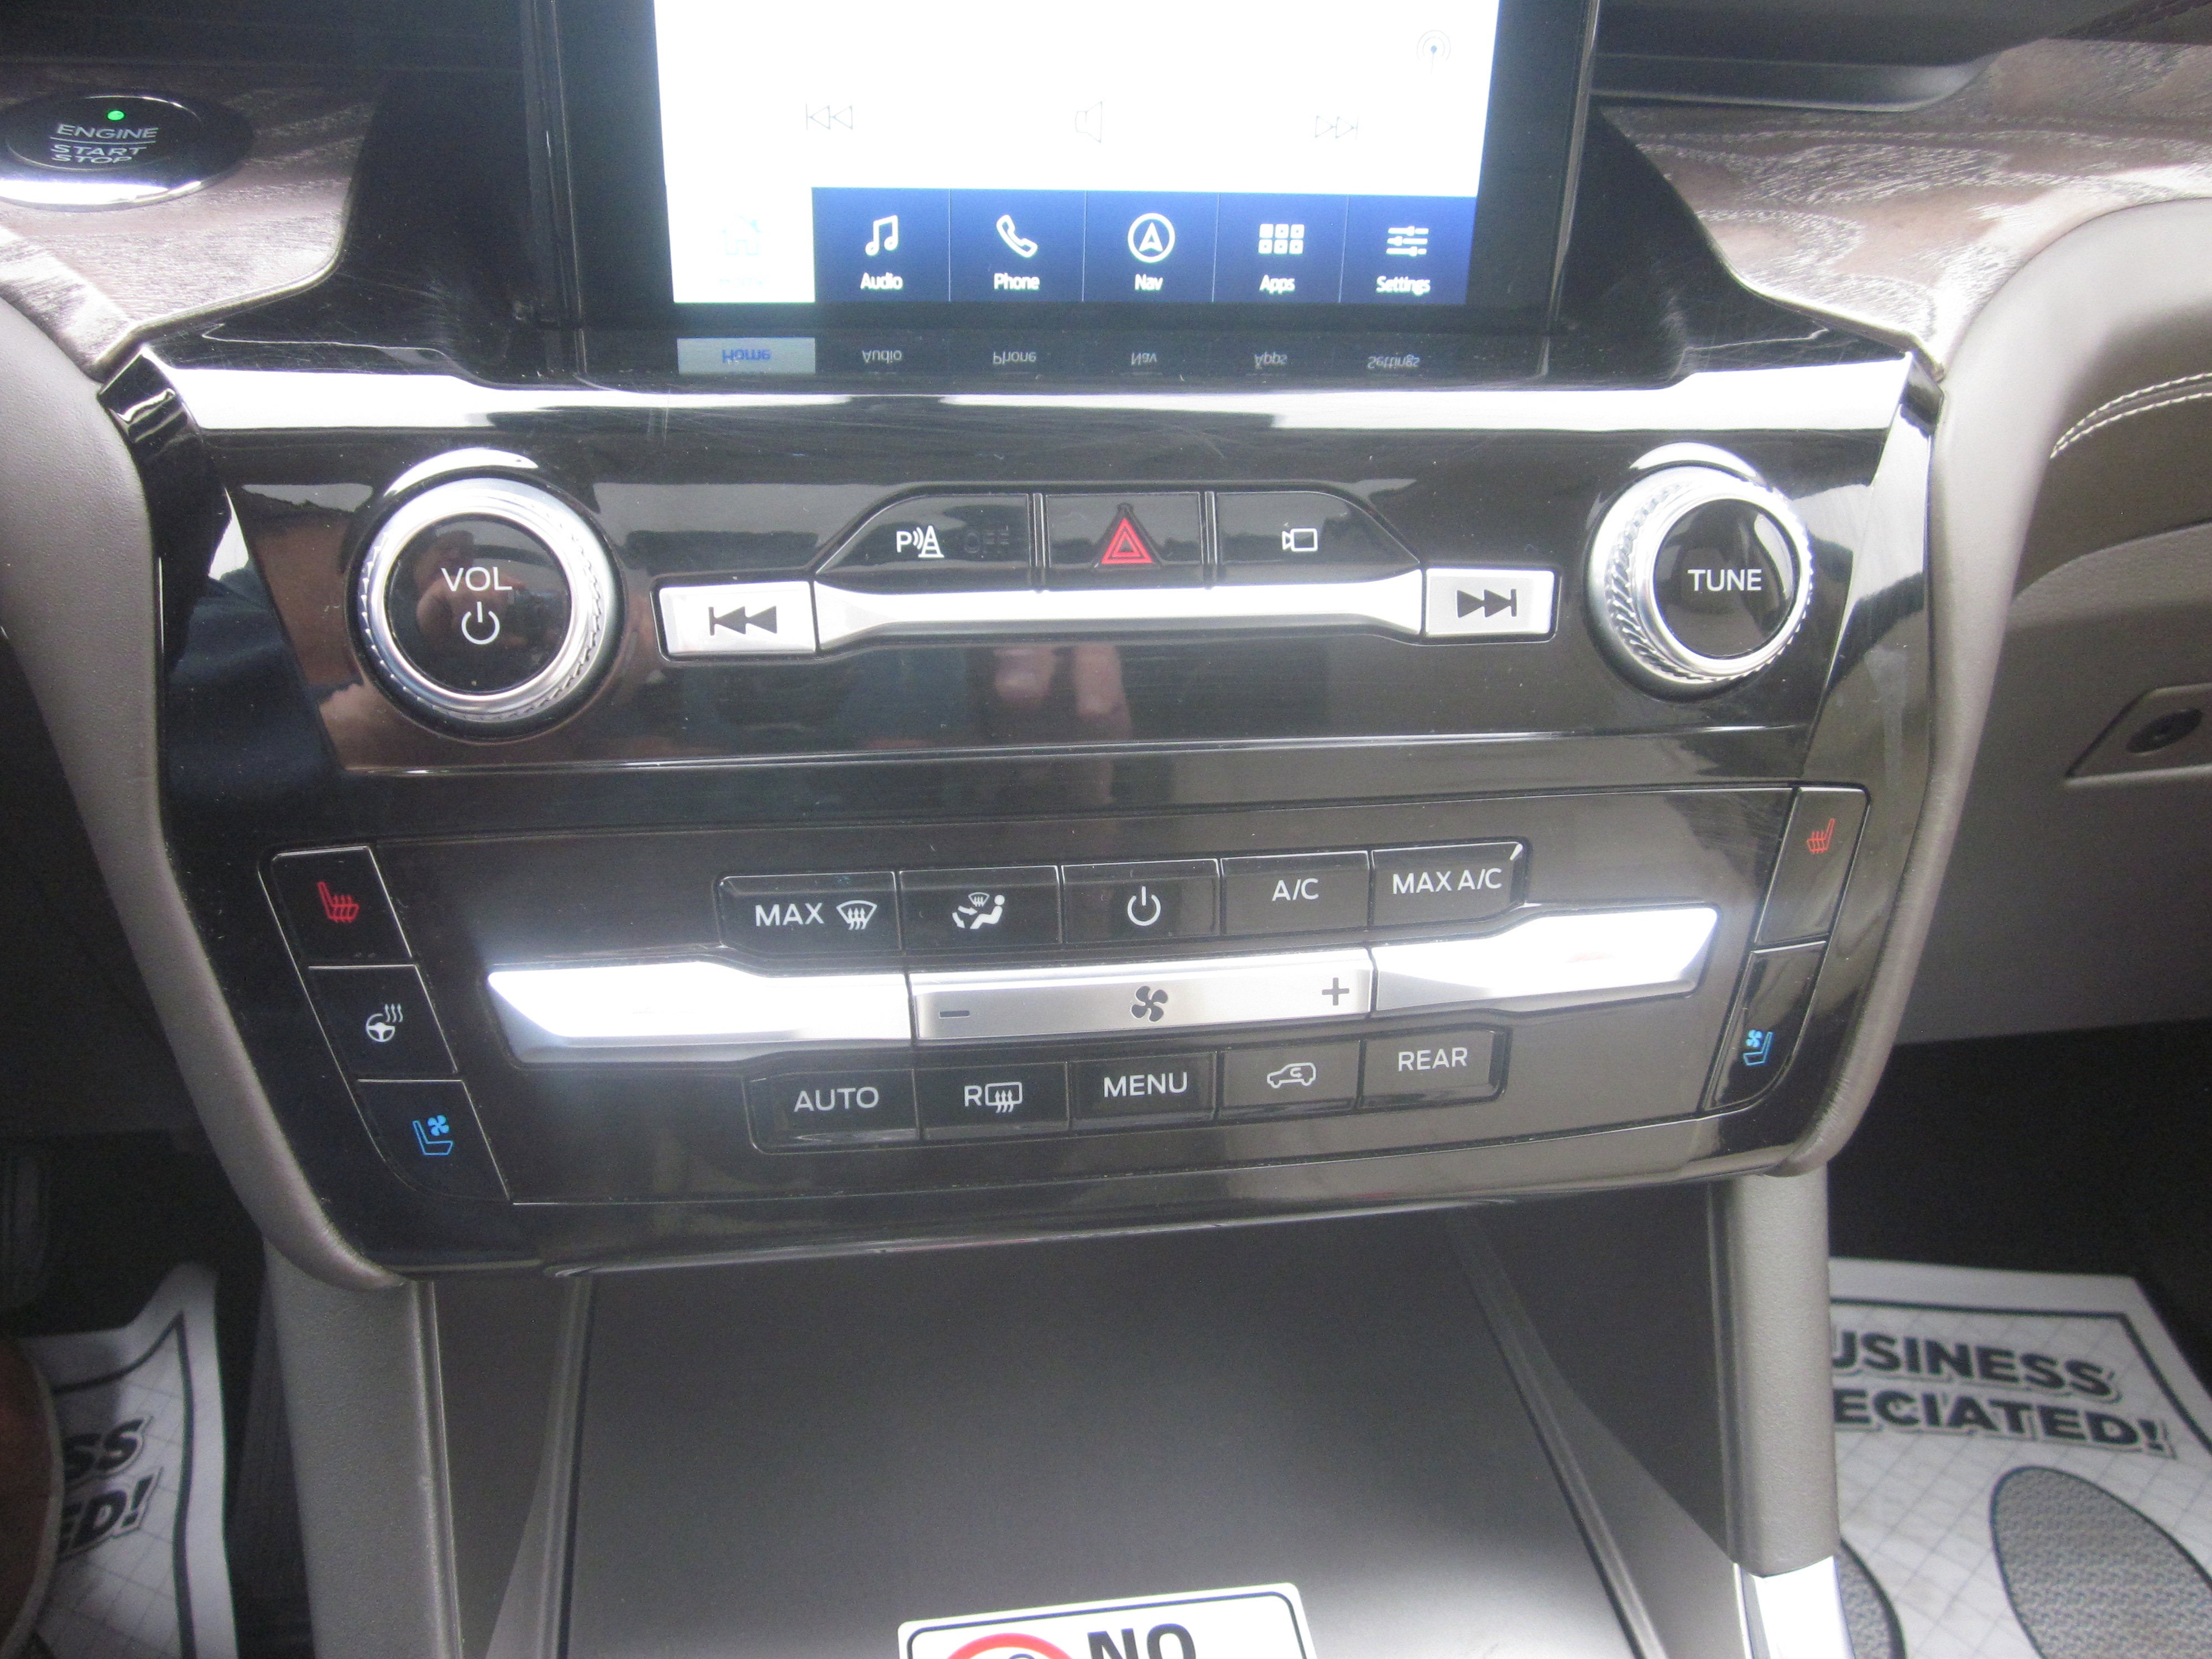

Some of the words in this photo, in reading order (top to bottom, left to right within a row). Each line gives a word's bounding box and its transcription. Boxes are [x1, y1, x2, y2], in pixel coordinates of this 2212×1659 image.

[56, 123, 159, 139] ENGINE
[51, 143, 147, 156] START
[51, 154, 133, 164] STOP
[860, 273, 902, 290] Audio
[994, 273, 1040, 290] Phone
[1135, 274, 1163, 291] Nav
[1260, 275, 1296, 294] Apps
[1376, 275, 1431, 296] Settings
[441, 566, 512, 592] VOL
[1687, 568, 1762, 592] TUNE
[1272, 877, 1319, 901] A/C
[1392, 870, 1453, 895] MAX
[1457, 868, 1503, 891] A/C
[755, 902, 825, 927] MAX
[1398, 1047, 1468, 1071] REAR
[1104, 1072, 1188, 1097] MENU
[794, 1086, 880, 1113] AUTO
[1832, 1388, 2165, 1451] ECIATED!
[1087, 1623, 1196, 1659] NO
